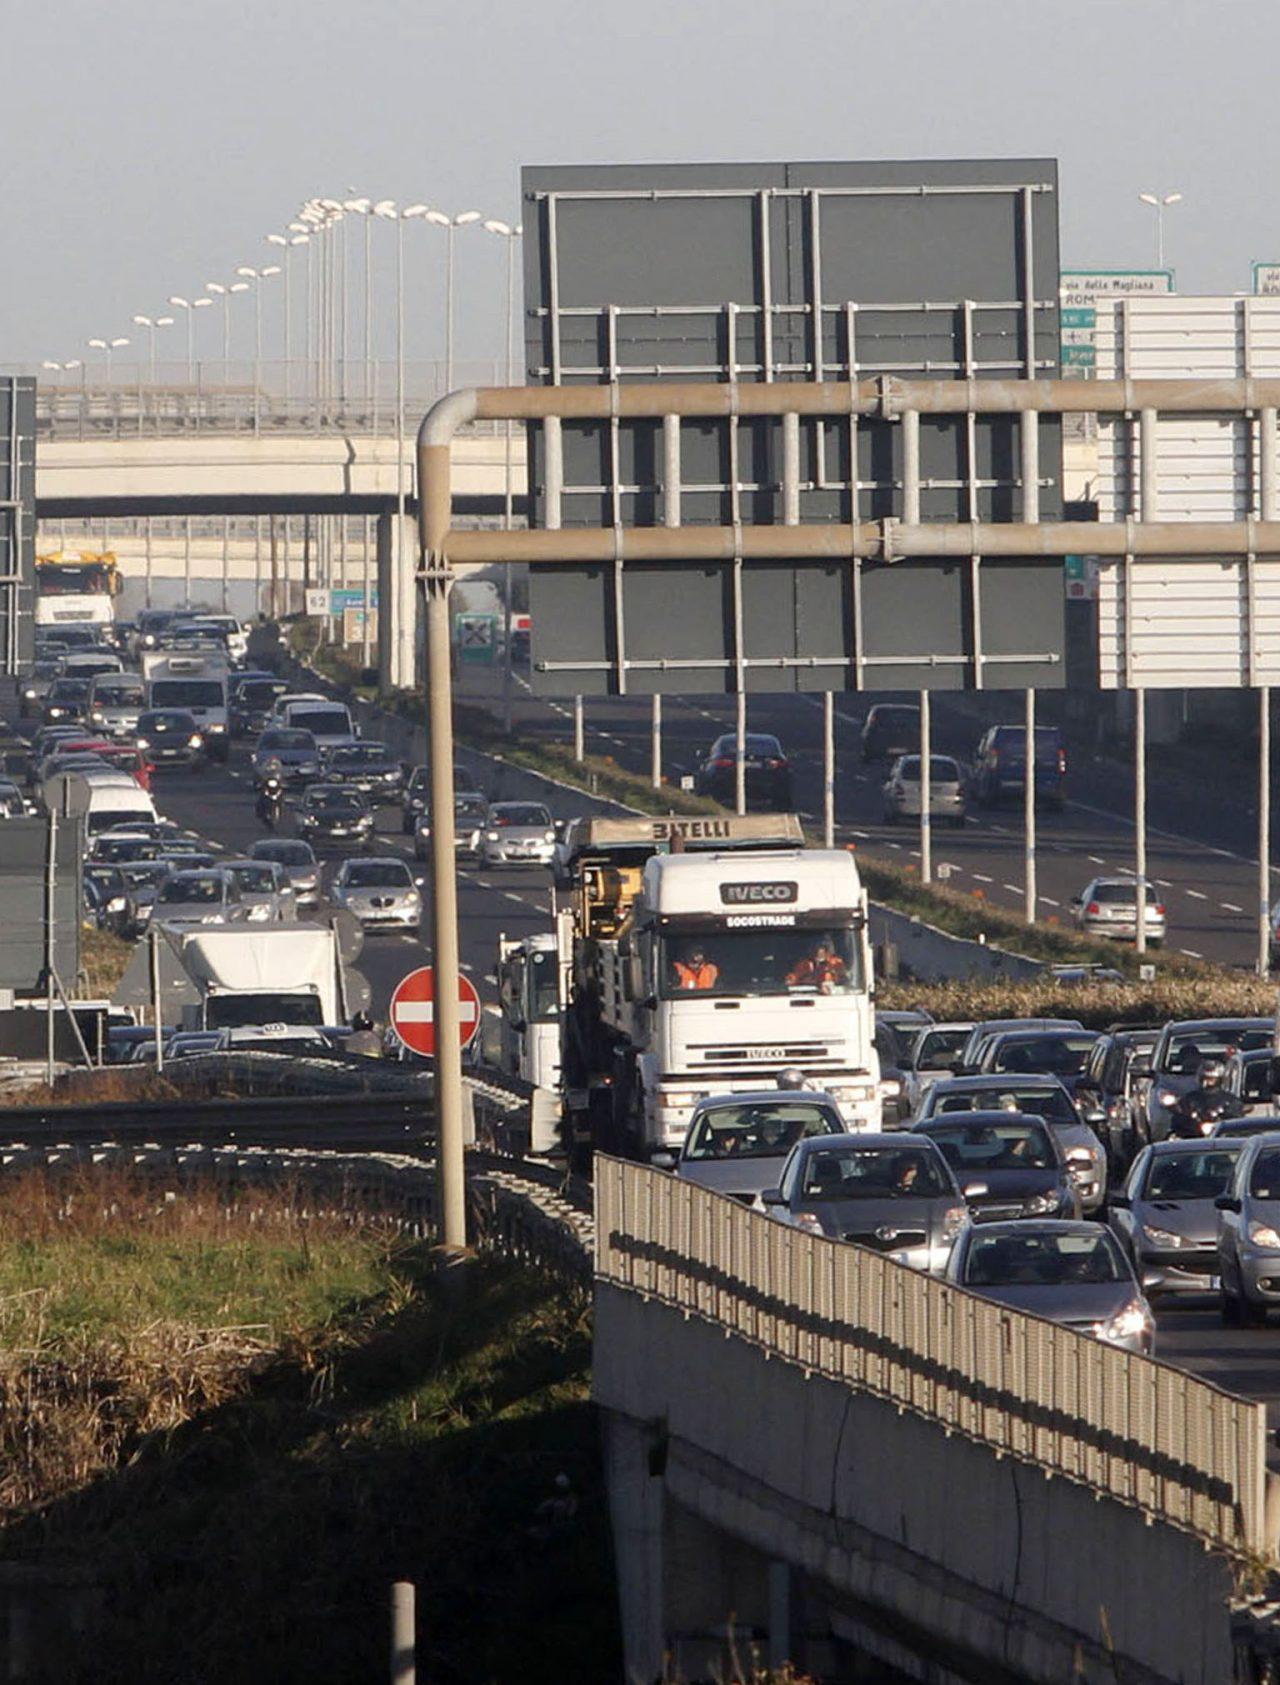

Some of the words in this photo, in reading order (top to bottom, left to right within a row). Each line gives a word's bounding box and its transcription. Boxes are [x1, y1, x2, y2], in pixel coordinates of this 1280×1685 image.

[1085, 280, 1107, 289] della
[1113, 280, 1154, 291] Magliana
[728, 886, 791, 900] IVECO
